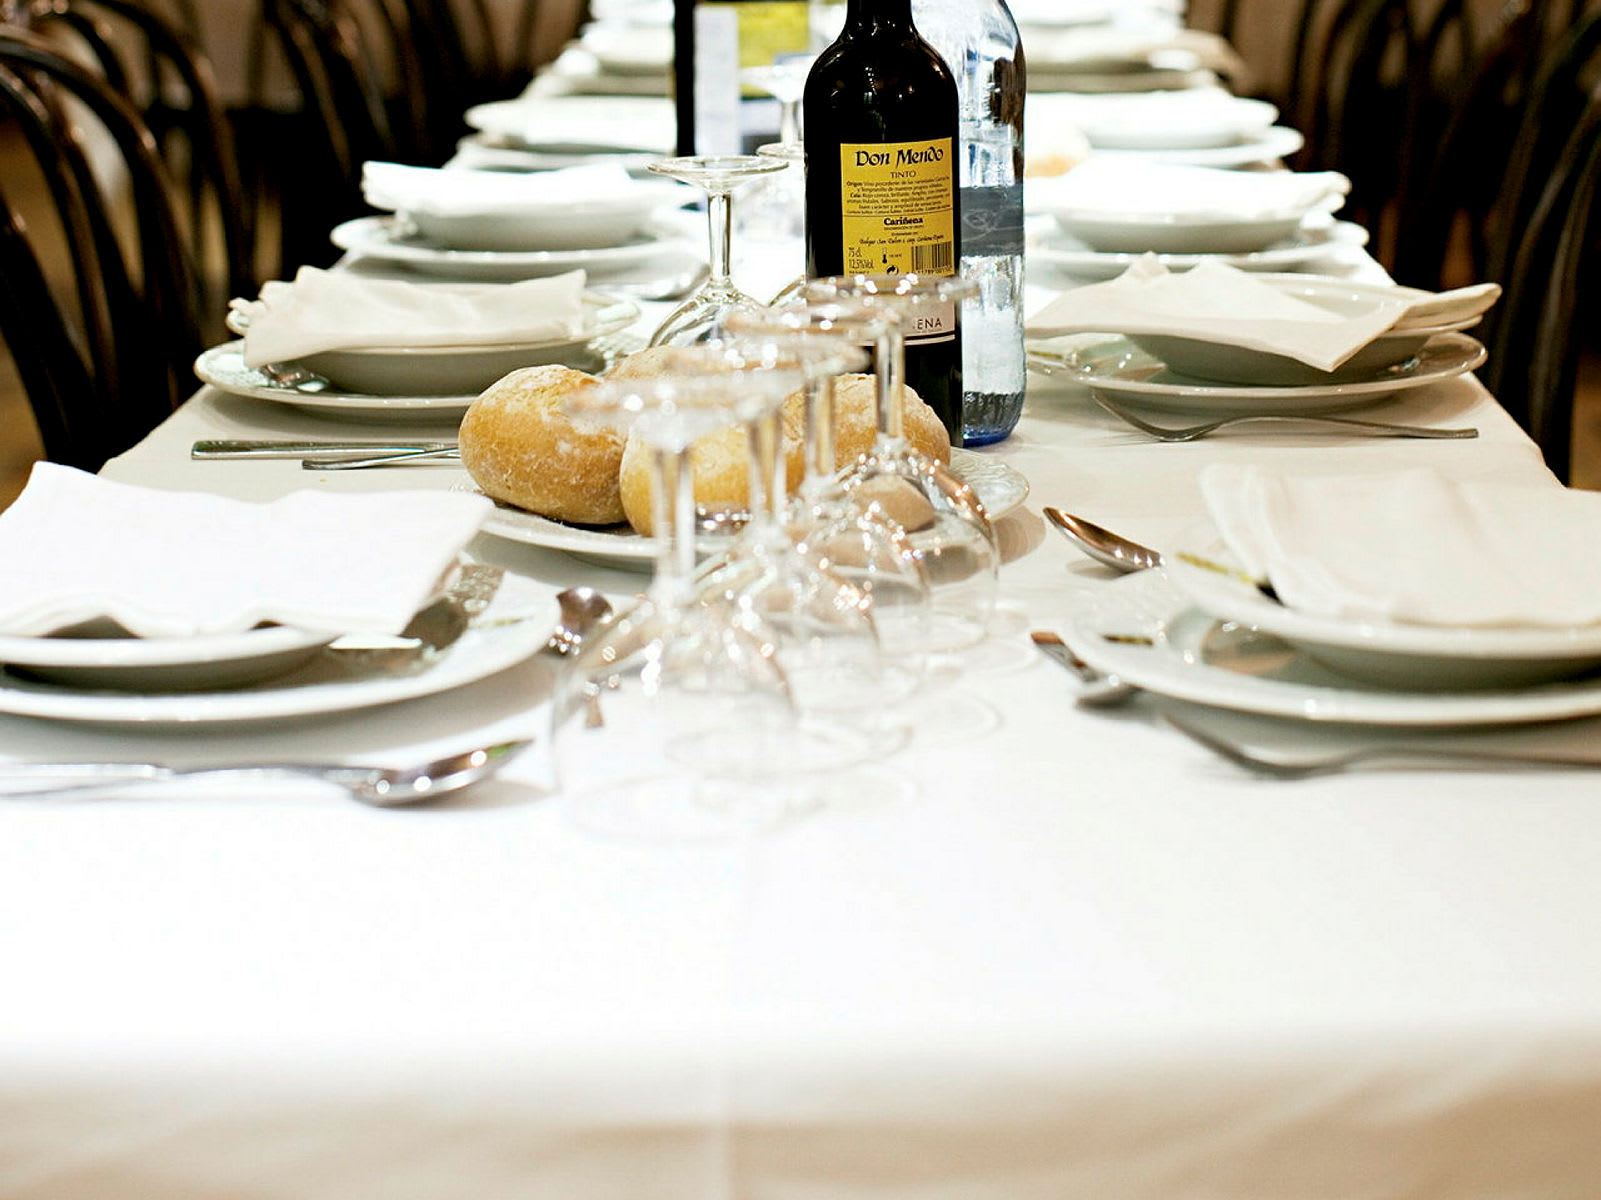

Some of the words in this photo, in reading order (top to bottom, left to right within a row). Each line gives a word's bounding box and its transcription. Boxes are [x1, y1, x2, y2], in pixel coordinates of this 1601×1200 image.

[855, 150, 890, 167] Don
[896, 146, 944, 169] Mendo
[890, 170, 917, 179] TINTO
[912, 317, 943, 331] ENA
